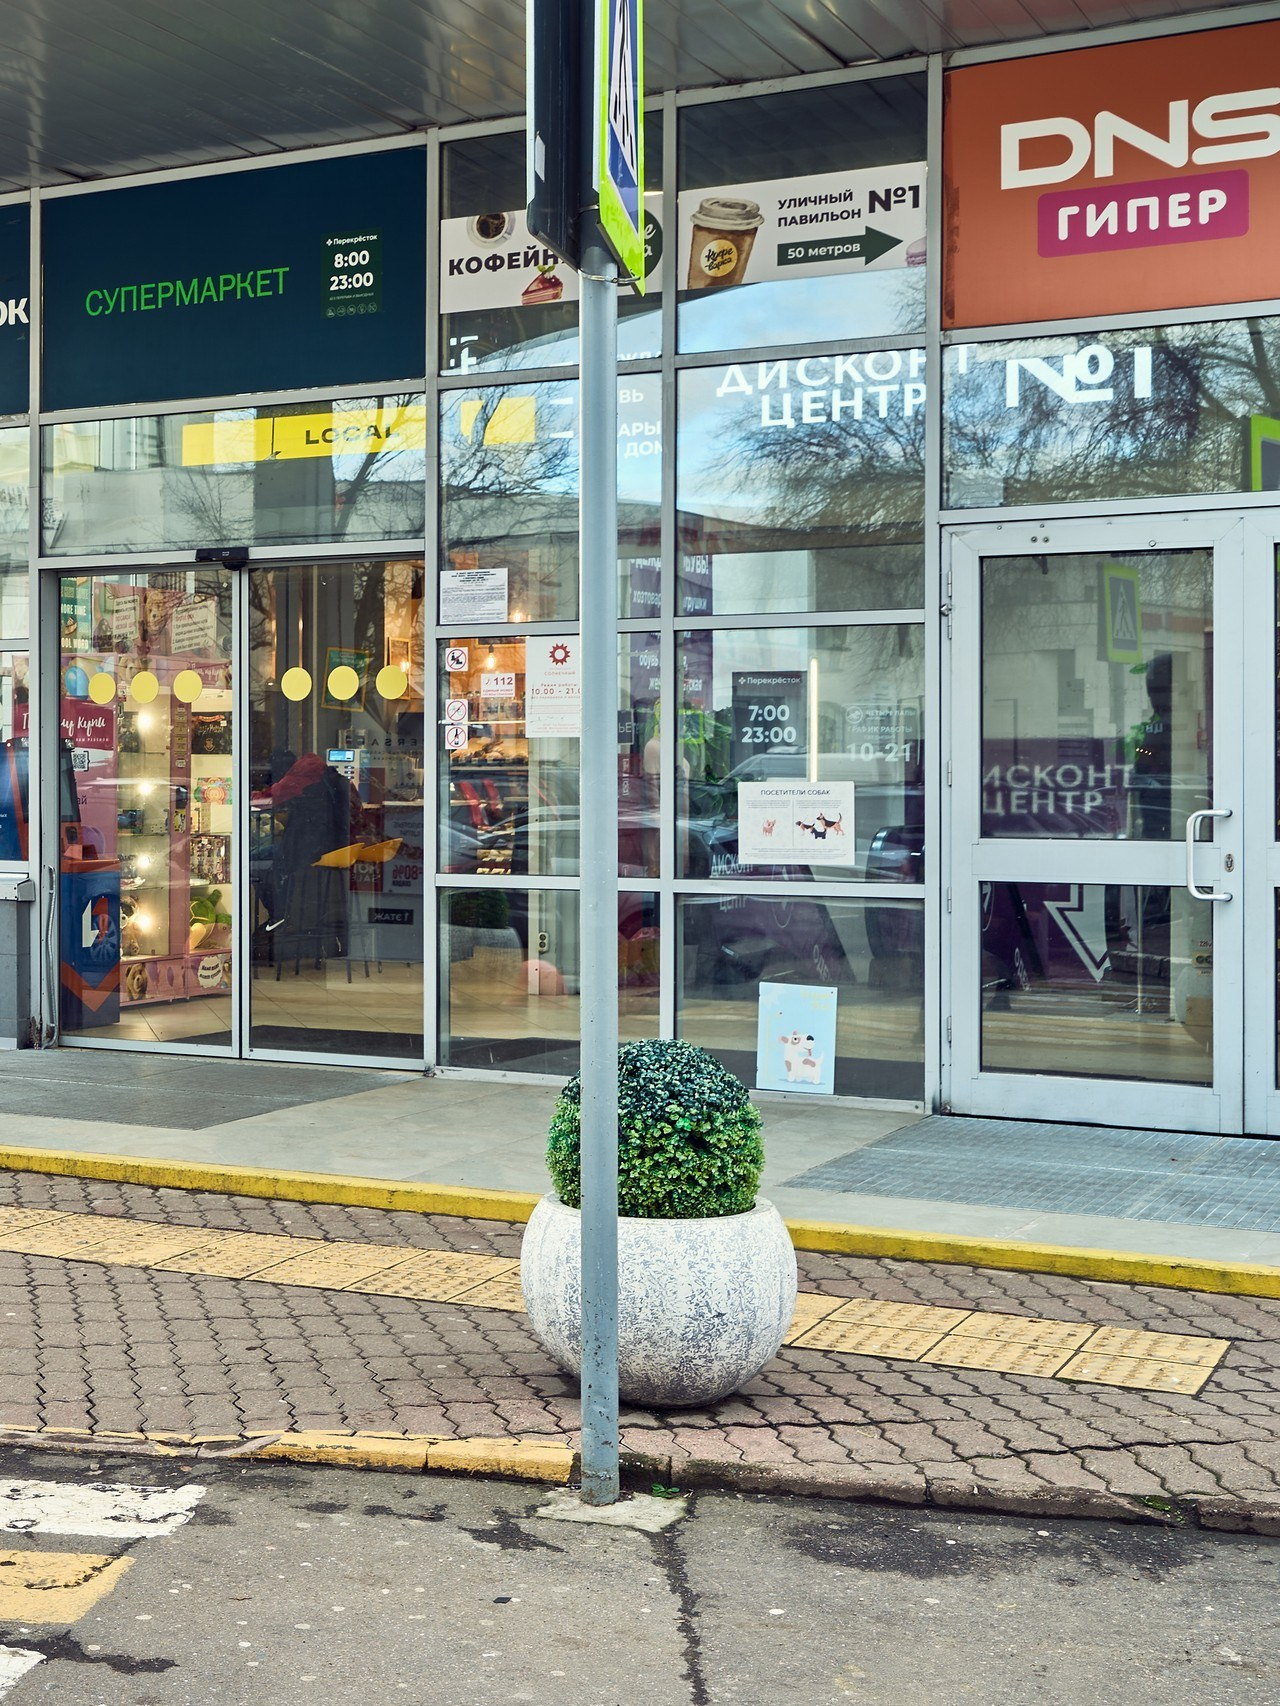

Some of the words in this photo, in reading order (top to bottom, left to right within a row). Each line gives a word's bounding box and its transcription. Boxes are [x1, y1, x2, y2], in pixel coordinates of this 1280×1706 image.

[1001, 87, 1280, 190] DNS
[777, 189, 854, 210] УЛИЧНЫЙ
[868, 184, 921, 214] №1
[777, 208, 862, 228] ПАВИЛЬОН
[1058, 189, 1227, 241] ГИПЕР
[334, 250, 370, 268] 8:00
[786, 245, 804, 259] 50
[808, 241, 861, 259] метров
[448, 246, 565, 277] КОФЕЙН
[329, 271, 374, 291] 23:00
[86, 267, 290, 317] СУПЕРМАРКЕТ
[761, 383, 926, 429] ЦЕНТР
[305, 423, 400, 445] LOCAL
[494, 676, 513, 686] 112
[747, 676, 801, 685] Перекрёсток
[748, 704, 790, 721] 7:00
[741, 726, 797, 743] 23:00
[983, 764, 1134, 788] ИСКОНТ
